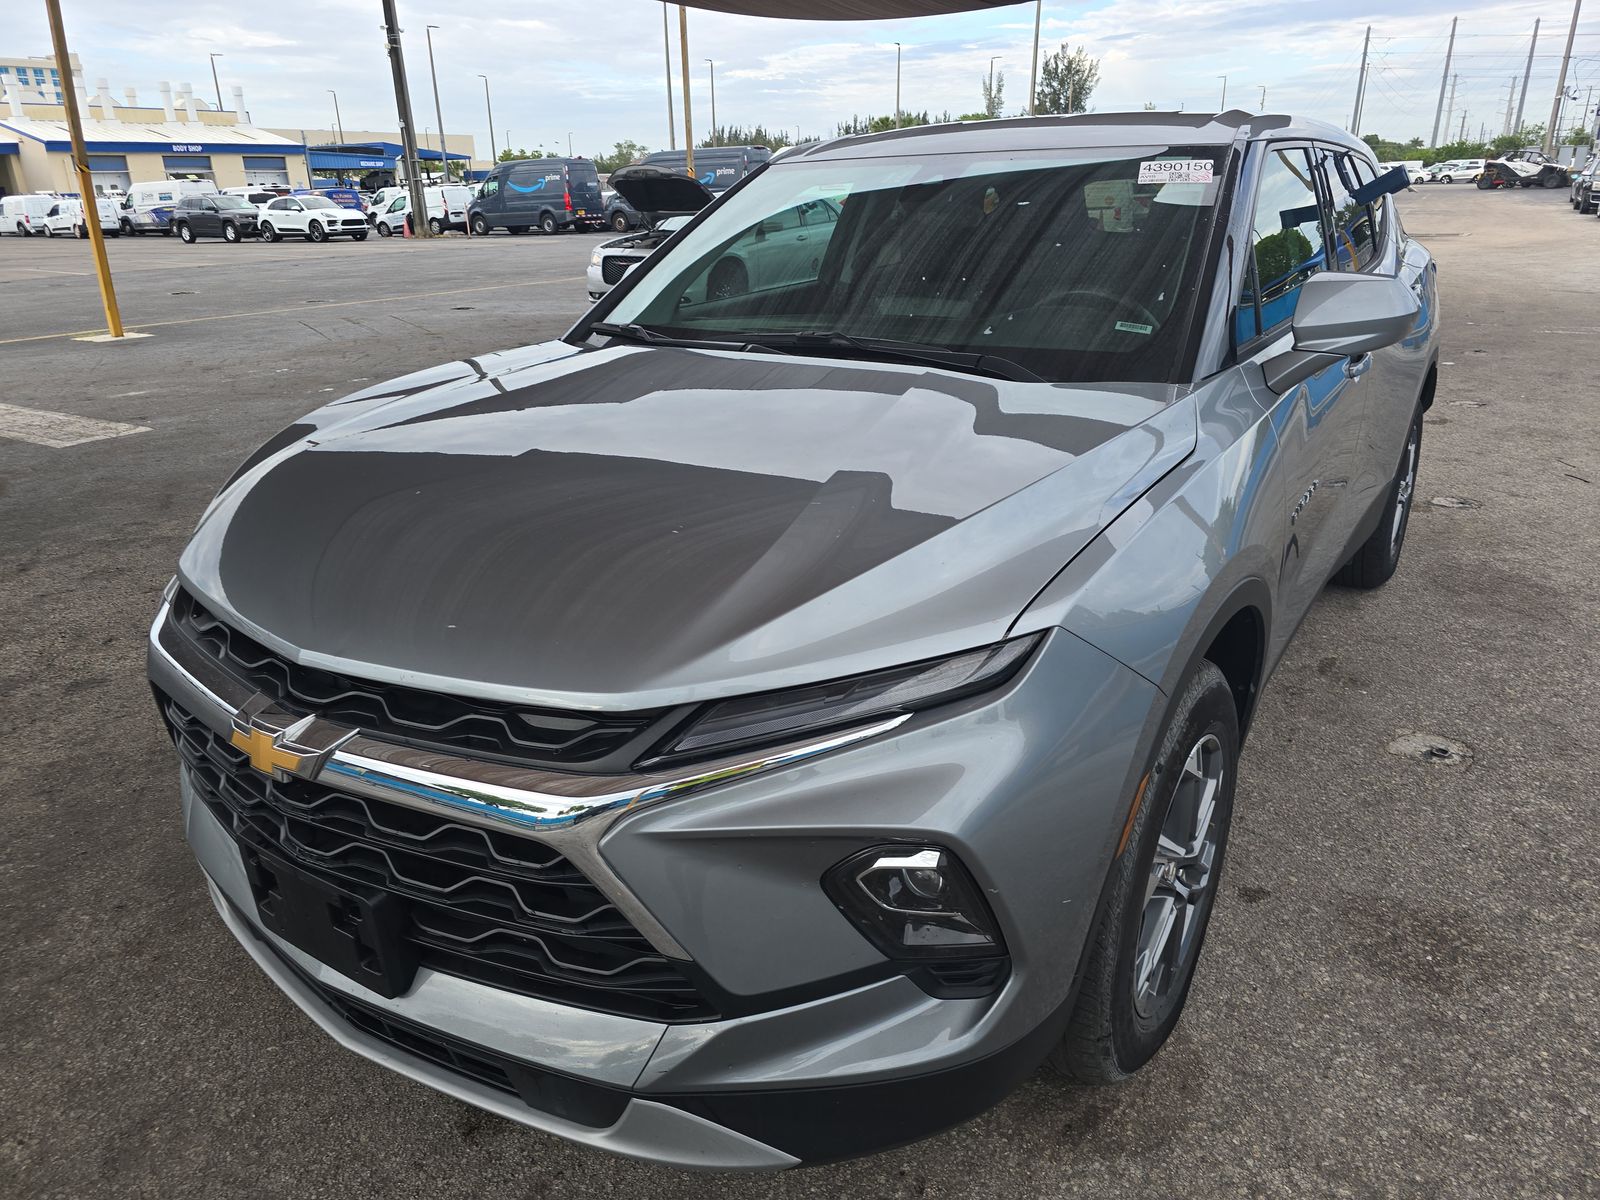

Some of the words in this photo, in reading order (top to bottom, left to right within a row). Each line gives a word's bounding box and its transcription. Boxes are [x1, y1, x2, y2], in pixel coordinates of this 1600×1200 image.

[172, 144, 187, 152] BODY
[187, 144, 203, 152] SHOP
[1143, 162, 1214, 171] 4390150
[716, 167, 735, 176] prime
[545, 174, 560, 182] prime
